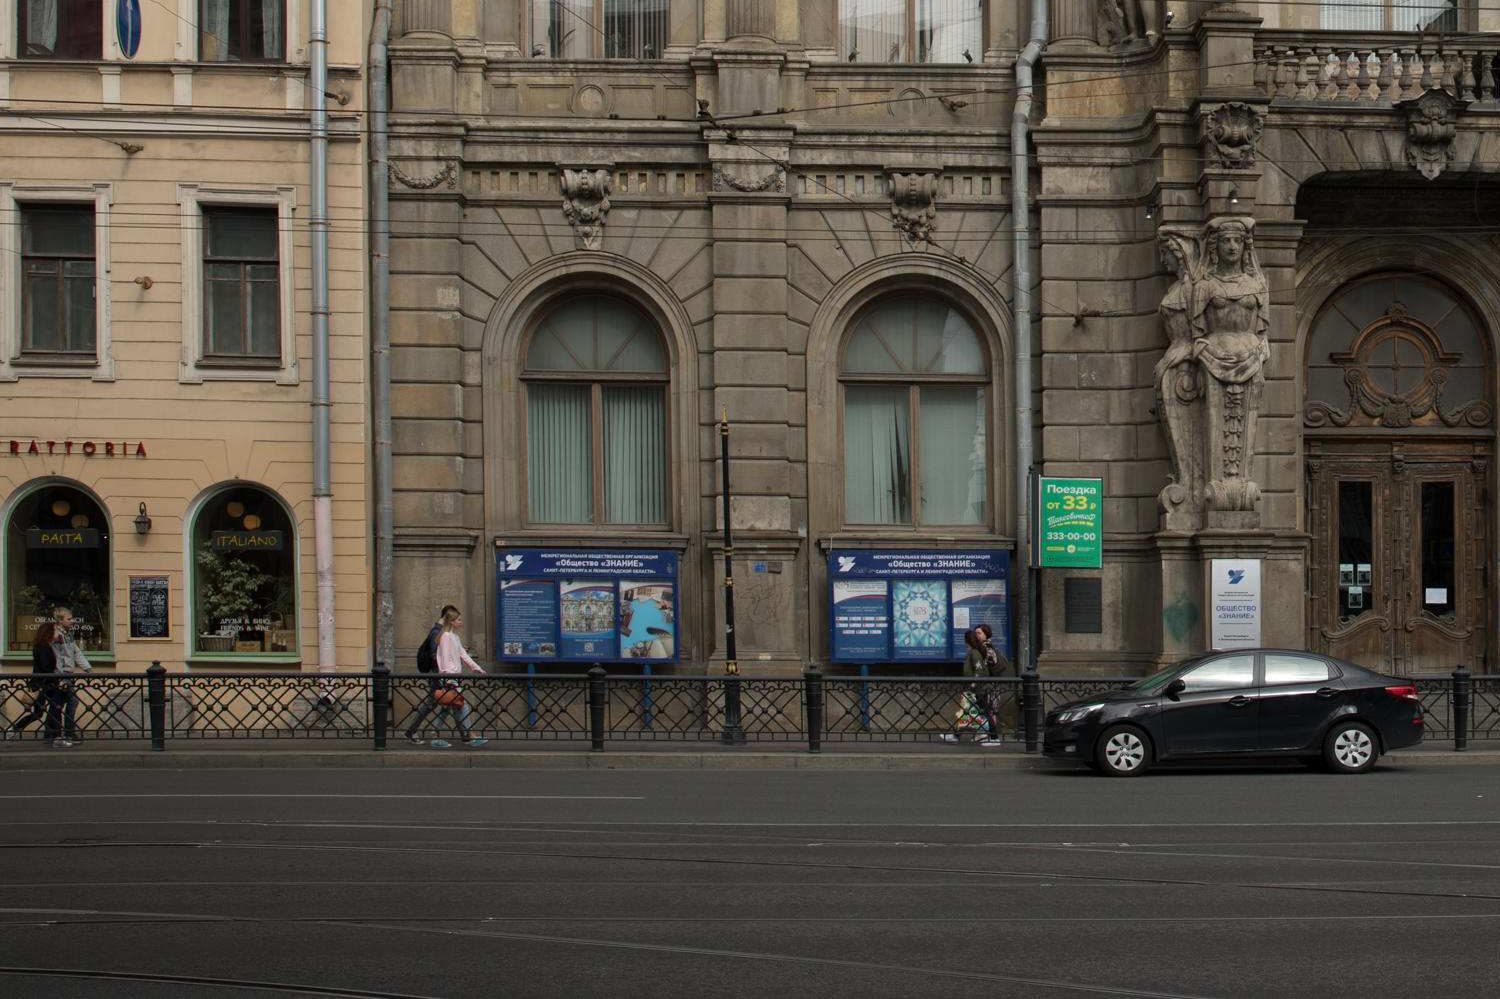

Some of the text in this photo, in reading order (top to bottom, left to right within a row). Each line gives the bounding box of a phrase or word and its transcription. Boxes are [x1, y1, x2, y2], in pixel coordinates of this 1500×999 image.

[0, 439, 148, 456] RATTORIA
[1047, 484, 1096, 495] Поездка
[1063, 495, 1087, 510] 33
[41, 533, 83, 545] PASTA
[217, 535, 277, 547] ITALIANO
[1047, 532, 1096, 541] 333-00-00
[556, 558, 644, 569] «Общество «ЗНАНИЕ»
[888, 559, 931, 569] «Общество
[933, 559, 976, 568] «ЗНАНИЕ»
